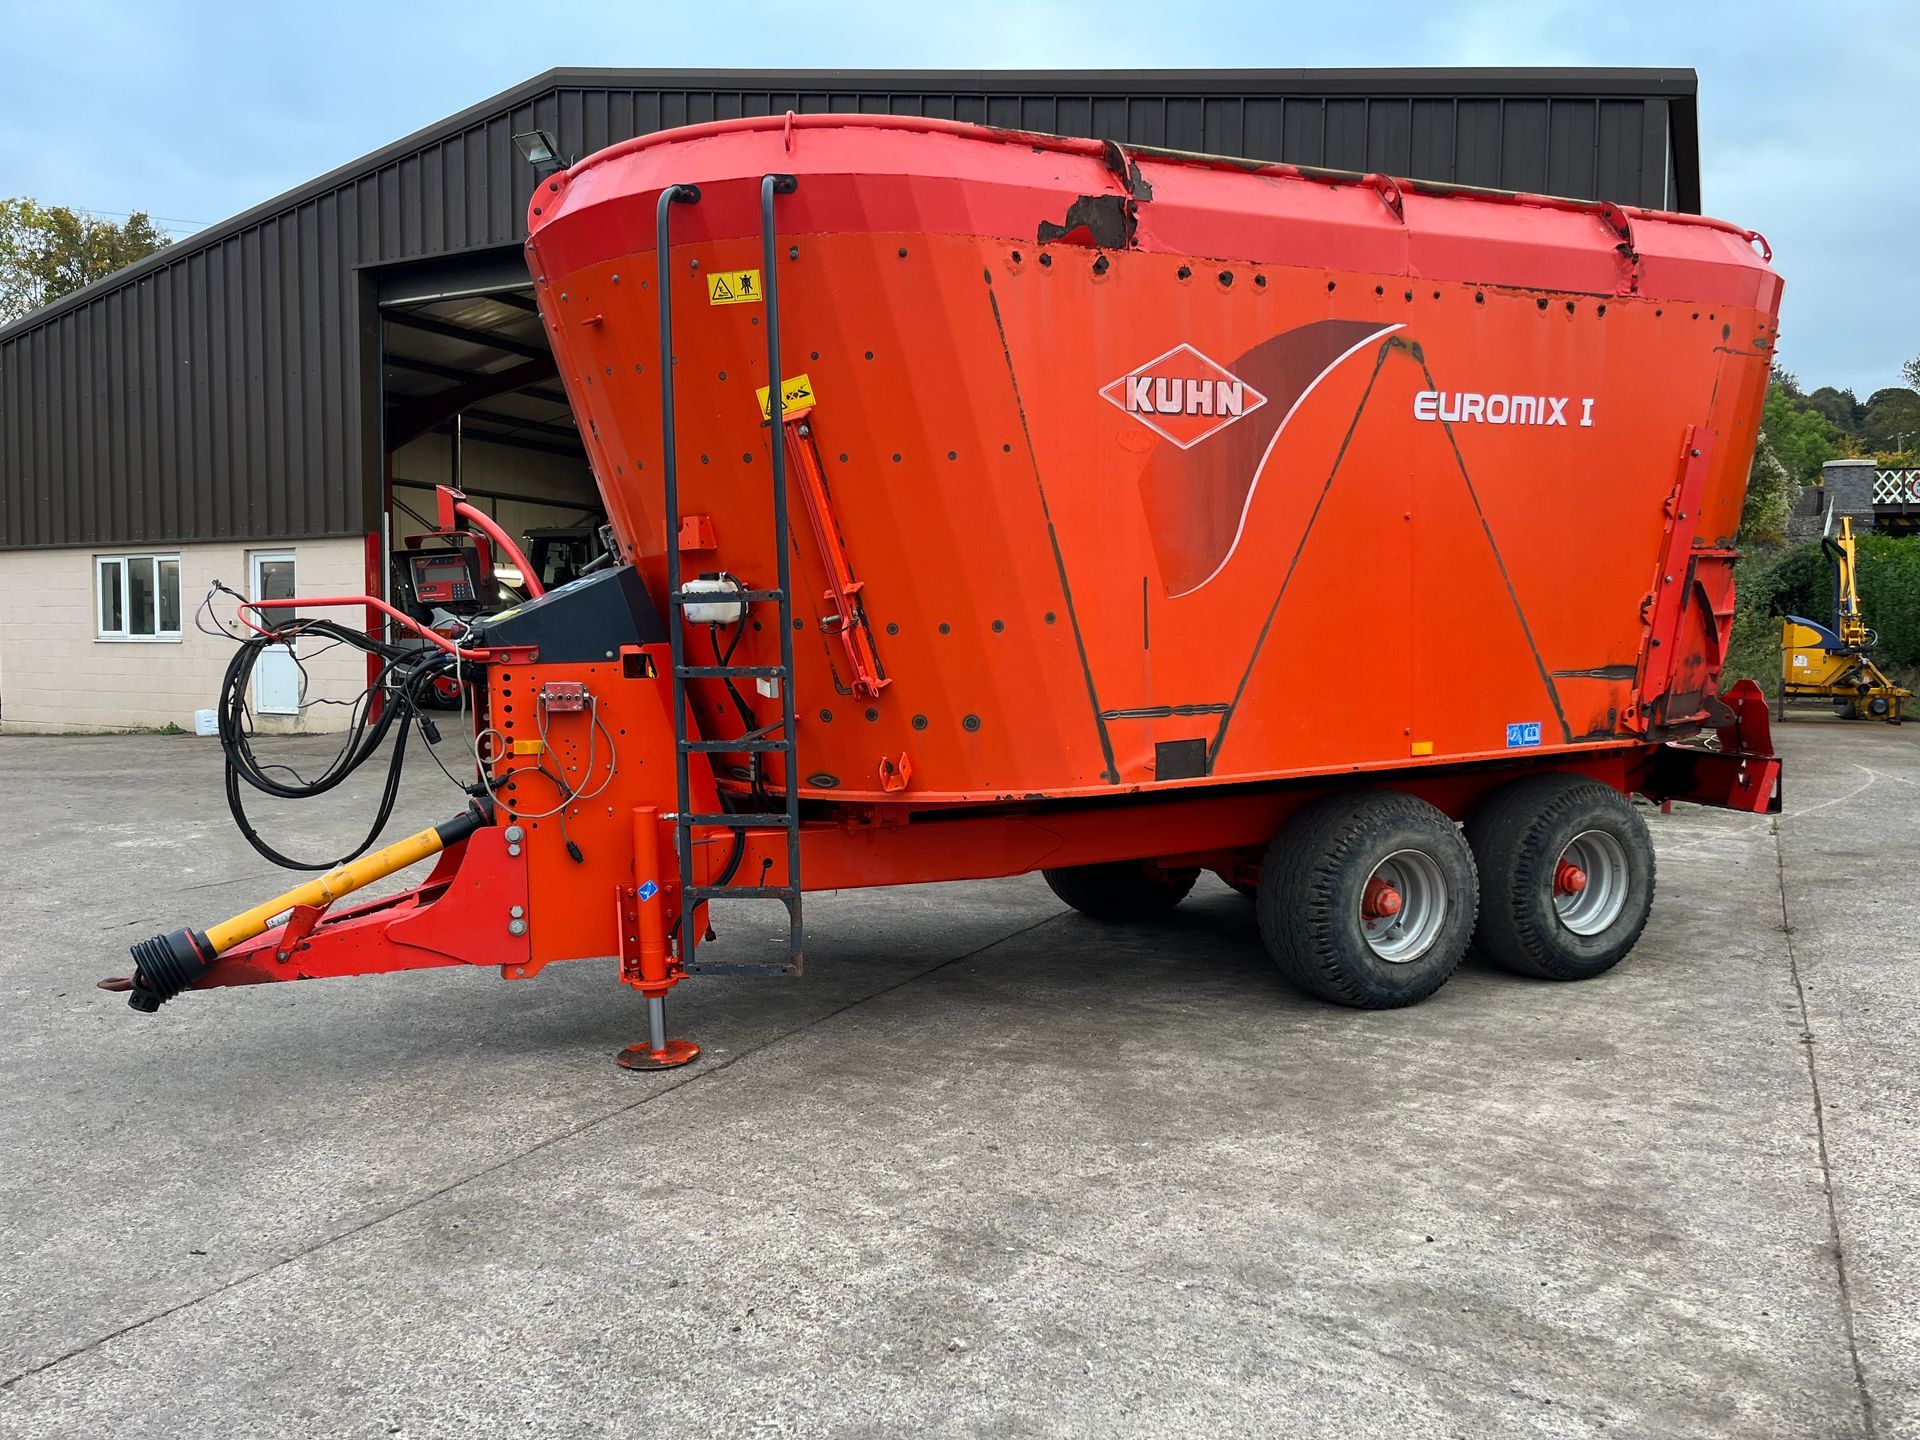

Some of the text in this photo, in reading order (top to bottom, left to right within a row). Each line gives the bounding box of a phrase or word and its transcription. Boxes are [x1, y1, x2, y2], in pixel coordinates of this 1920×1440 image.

[1126, 376, 1243, 416] KUHN
[1413, 391, 1594, 427] EUROMIX I
